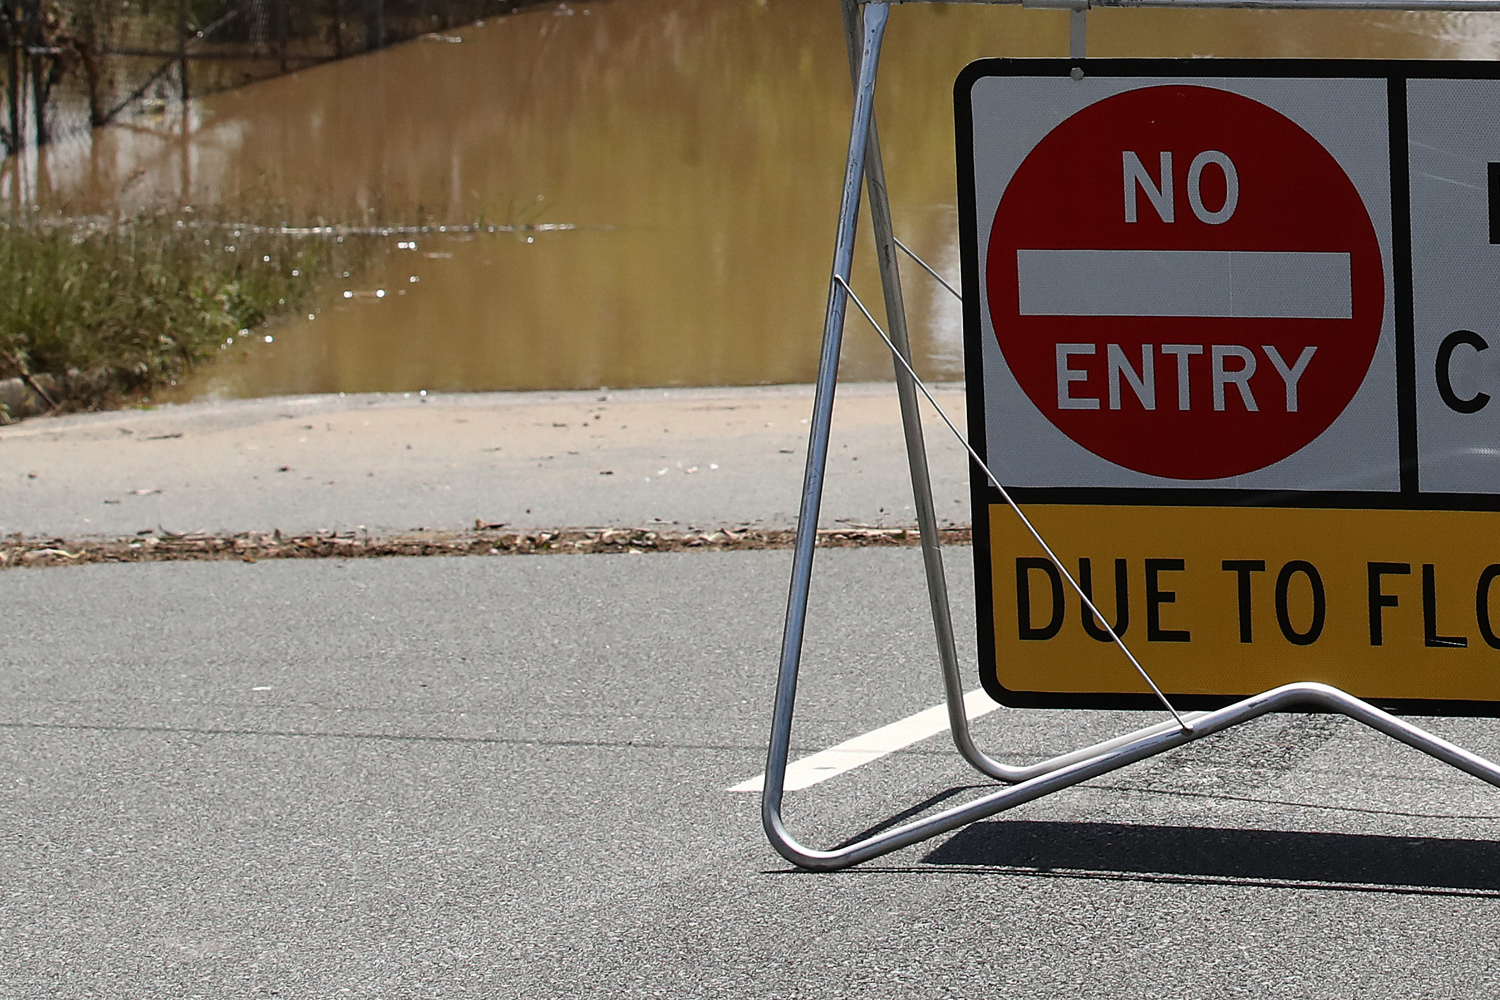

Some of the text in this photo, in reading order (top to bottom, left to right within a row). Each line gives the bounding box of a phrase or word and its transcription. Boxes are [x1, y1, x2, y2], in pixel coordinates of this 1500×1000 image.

[1122, 150, 1239, 225] NO
[1055, 343, 1318, 413] ENTRY
[1015, 556, 1190, 643] DUE
[1221, 559, 1327, 646] TO
